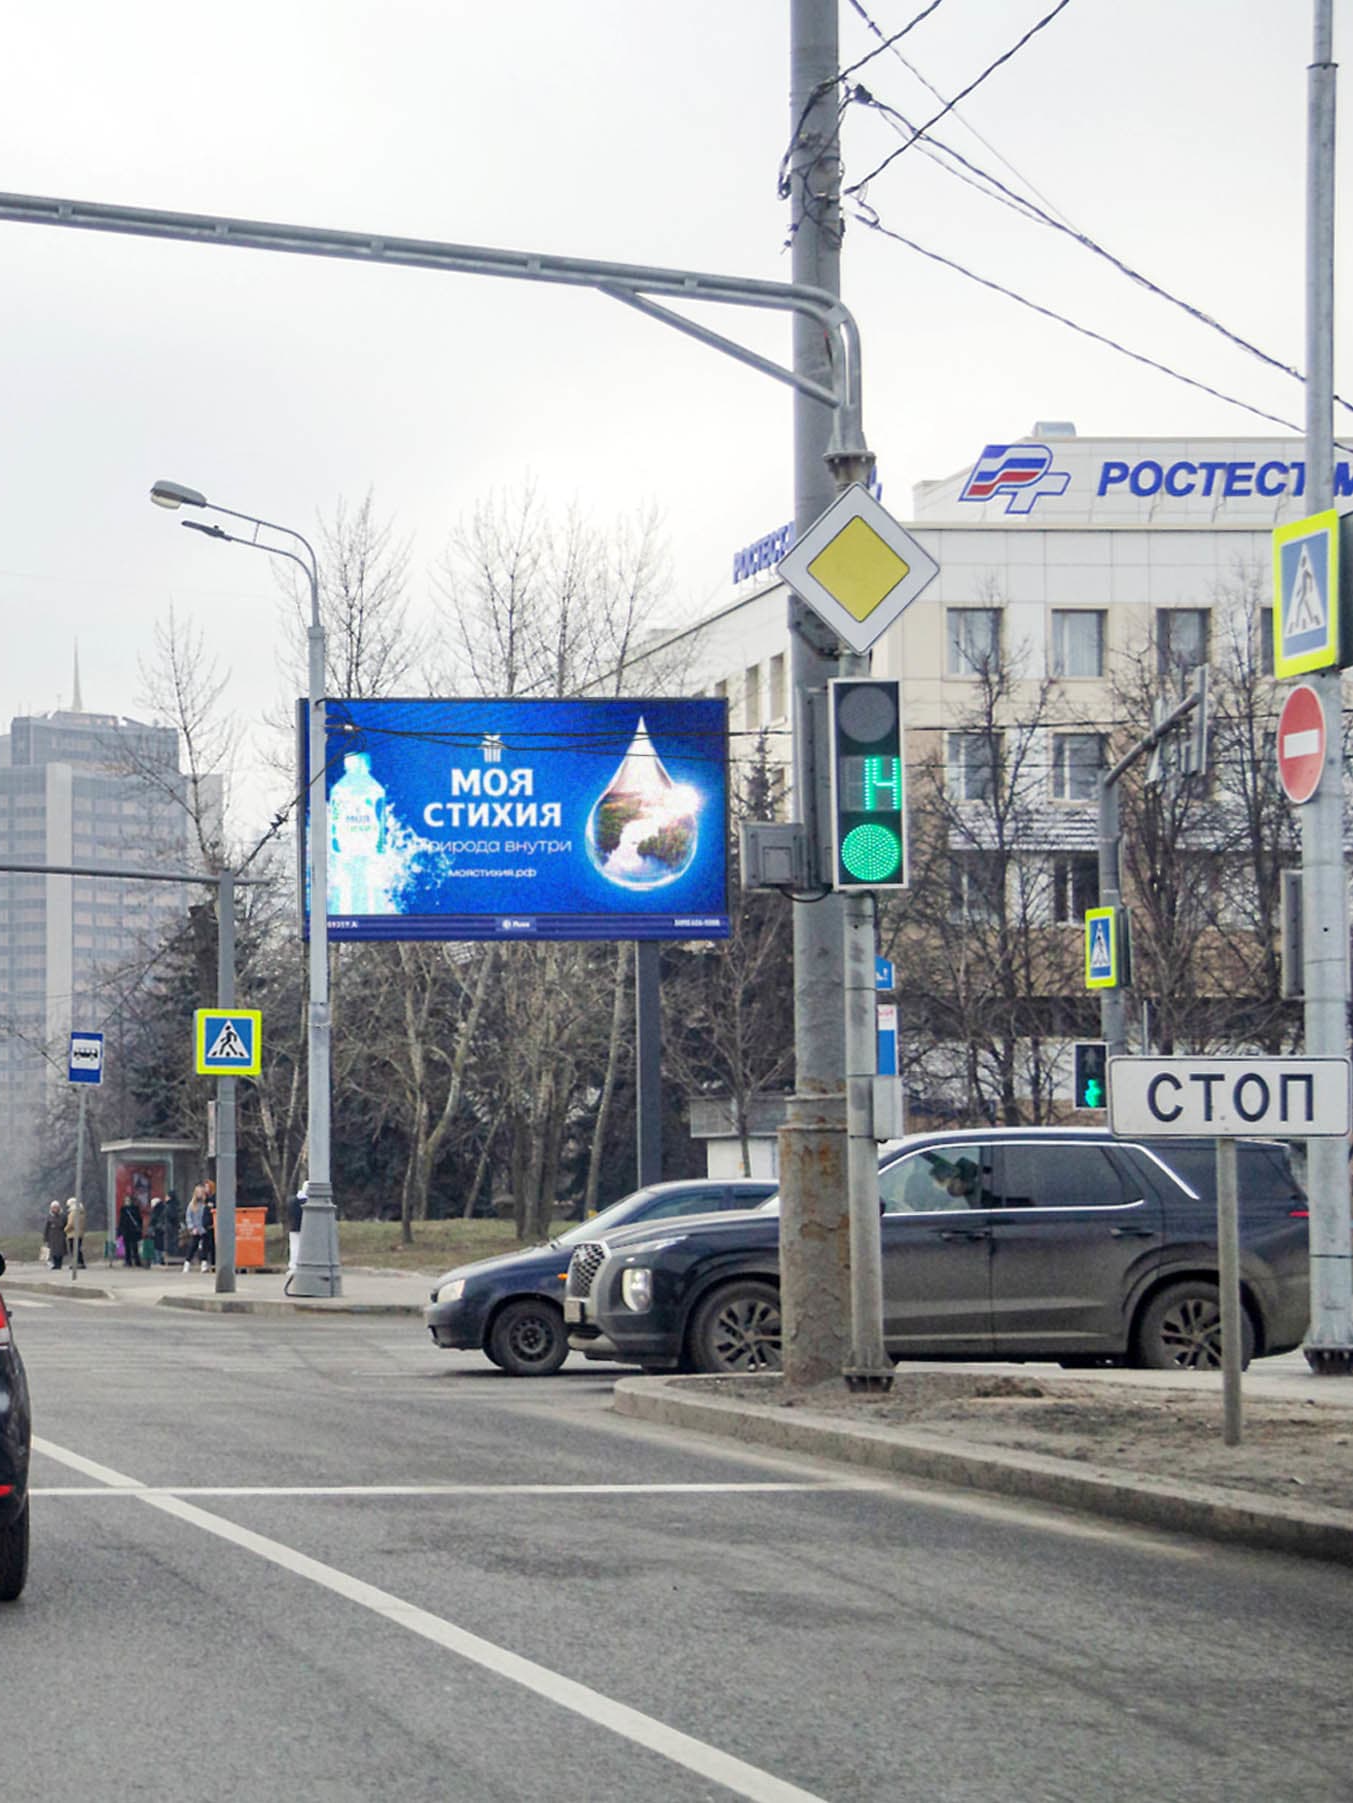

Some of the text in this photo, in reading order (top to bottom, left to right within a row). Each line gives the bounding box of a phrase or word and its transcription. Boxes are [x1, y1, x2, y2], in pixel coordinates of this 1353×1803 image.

[1097, 460, 1307, 498] РОСТЕСТ
[451, 768, 534, 797] МОЯ
[863, 757, 902, 811] 14
[423, 802, 562, 828] СТИХИЯ
[415, 839, 572, 855] рирода внутри
[1148, 1072, 1314, 1123] СТОП
